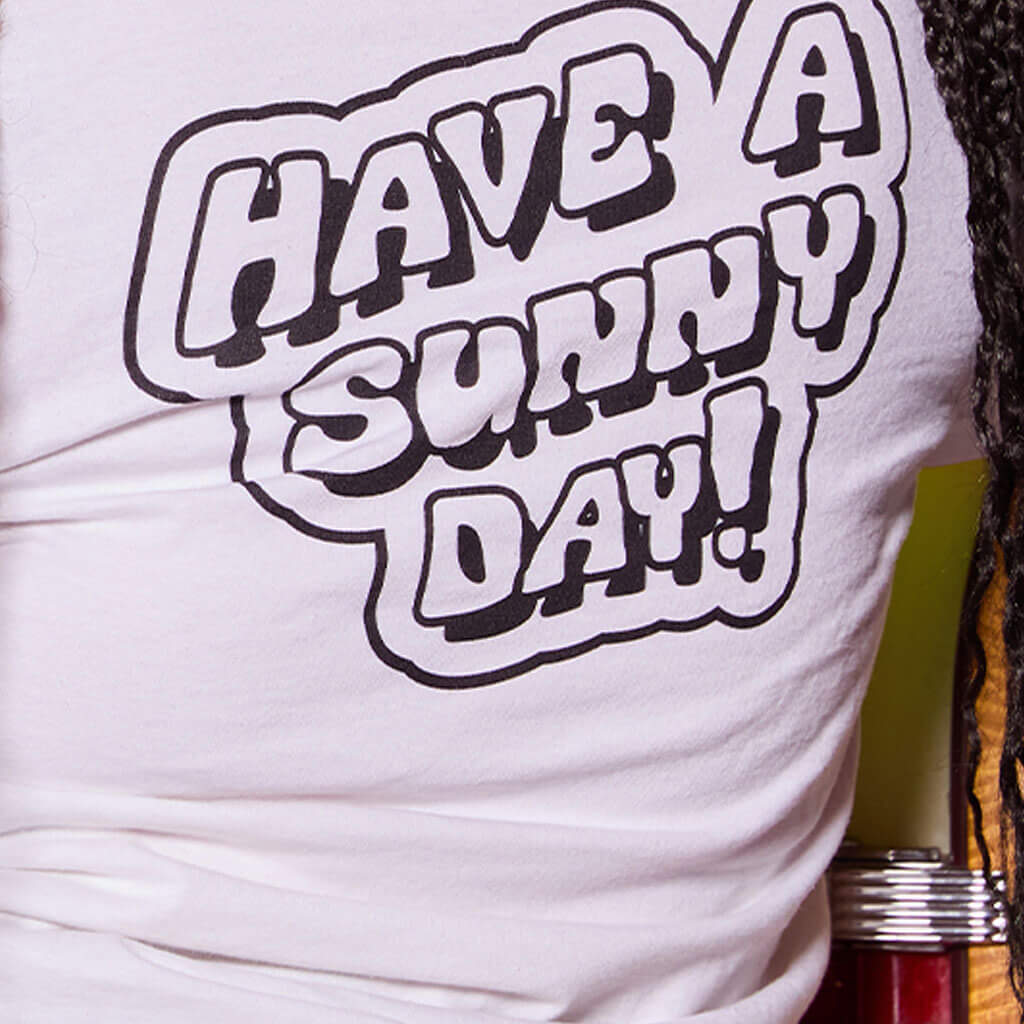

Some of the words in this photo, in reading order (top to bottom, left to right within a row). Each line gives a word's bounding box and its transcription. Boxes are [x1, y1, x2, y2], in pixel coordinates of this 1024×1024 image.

[176, 43, 675, 367] HAVE
[742, 2, 881, 179] A
[282, 184, 876, 497] SUNNY
[412, 377, 780, 642] DAY!
